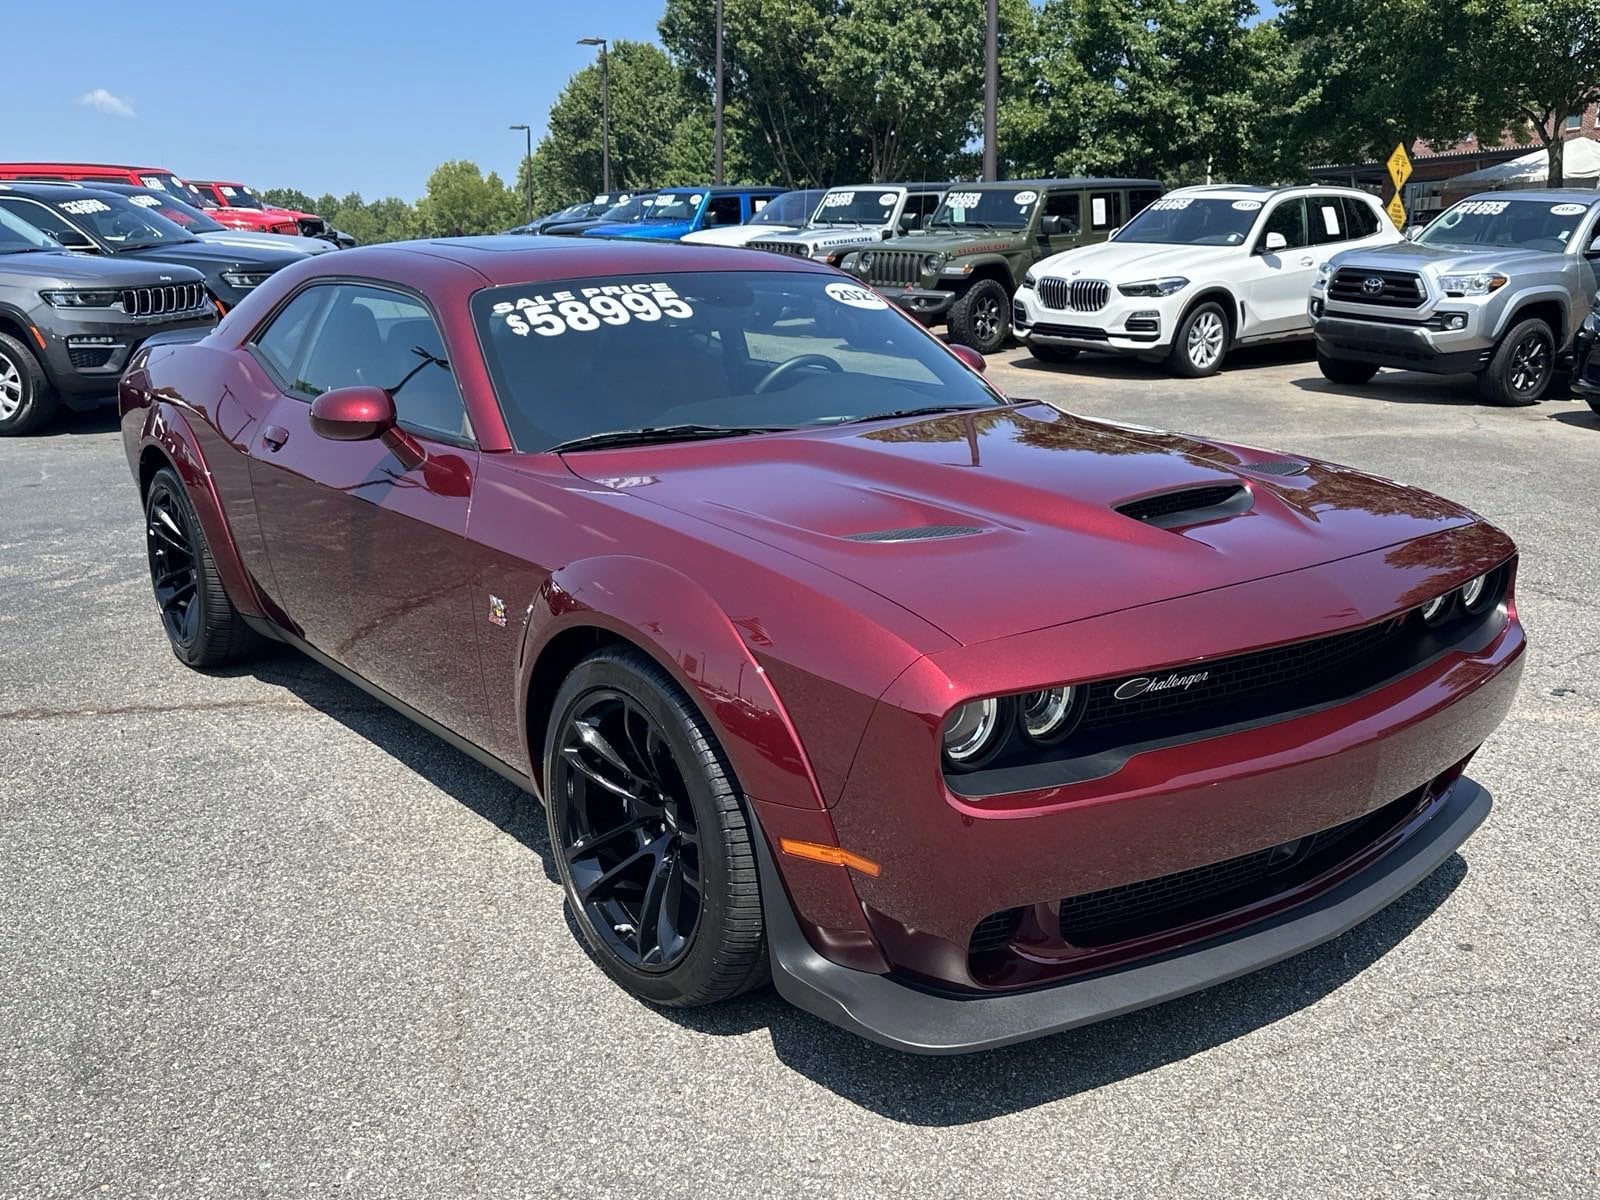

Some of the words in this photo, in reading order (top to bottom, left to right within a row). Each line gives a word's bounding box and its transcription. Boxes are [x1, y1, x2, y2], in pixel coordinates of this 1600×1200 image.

[823, 236, 873, 246] RUBICON
[493, 290, 577, 314] SALE
[580, 282, 674, 298] PRICE
[505, 291, 694, 337] $58995
[1113, 671, 1209, 700] Challenger
